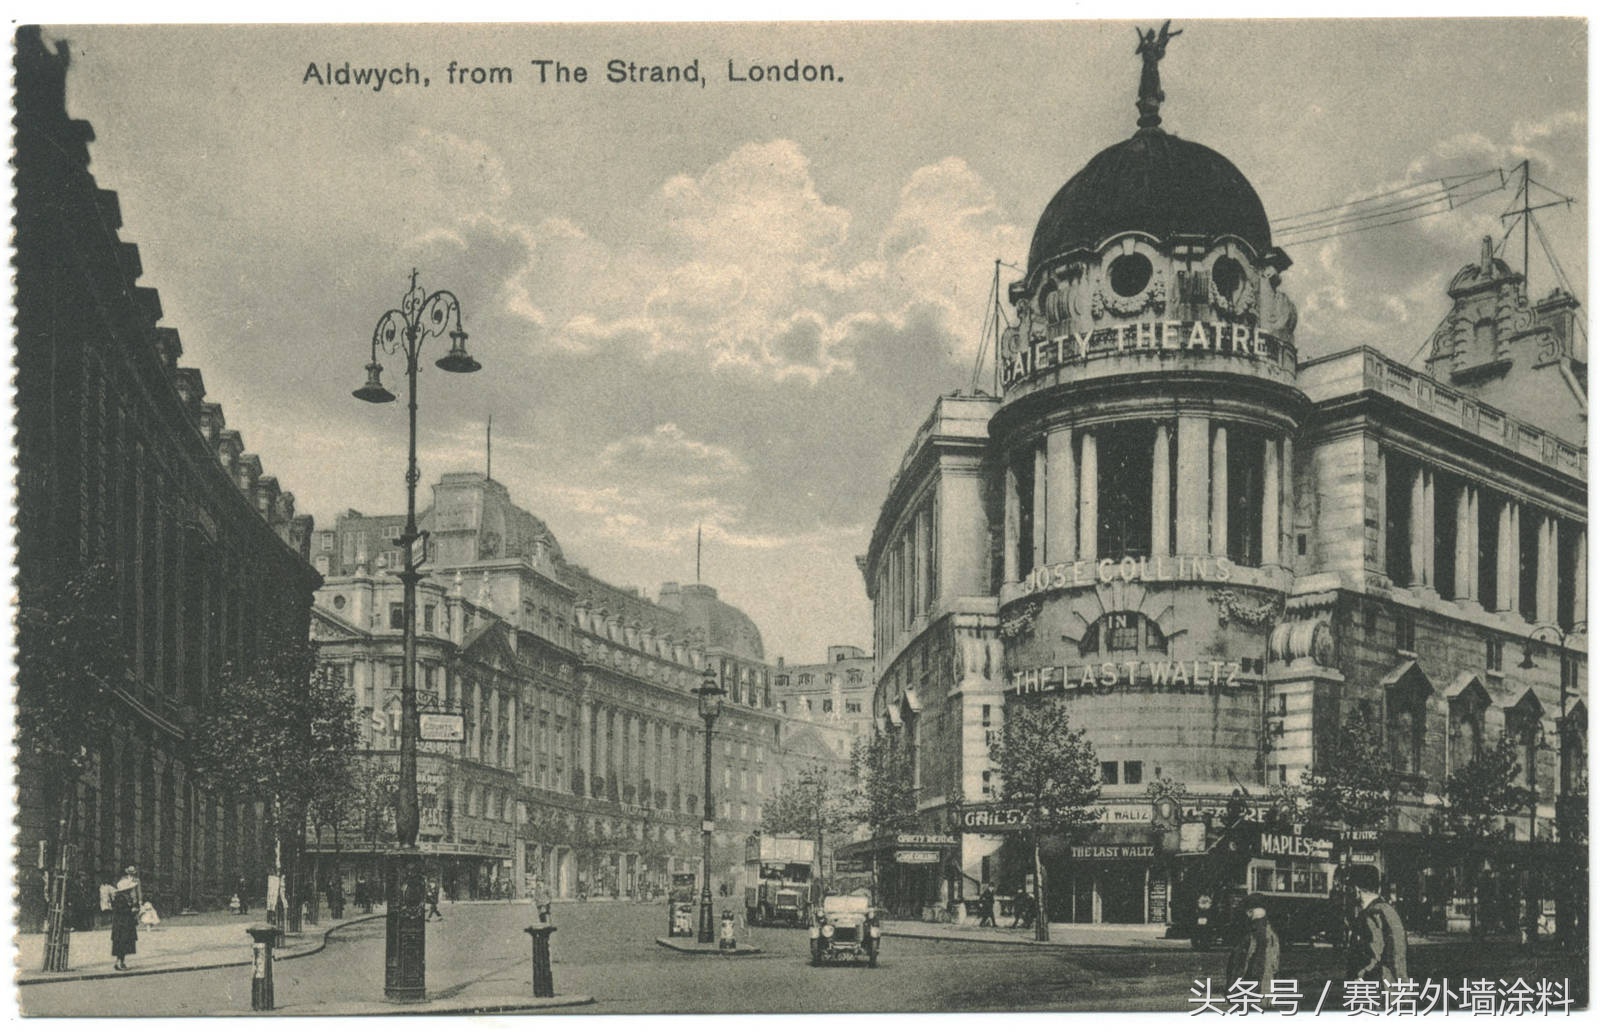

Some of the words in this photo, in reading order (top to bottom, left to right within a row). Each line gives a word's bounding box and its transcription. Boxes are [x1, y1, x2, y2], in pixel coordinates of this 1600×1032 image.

[1000, 329, 1093, 386] GAIETY
[1110, 319, 1271, 357] THEATRE
[1098, 556, 1231, 583] COLLINS
[1108, 614, 1127, 628] IN
[1013, 666, 1056, 696] THE
[1062, 660, 1142, 690] LAST
[1149, 660, 1242, 689] WALTZ
[1071, 846, 1093, 858] THE
[1093, 846, 1120, 858] LAST
[1121, 846, 1156, 858] WALTZ
[1260, 832, 1312, 857] MAPLES
